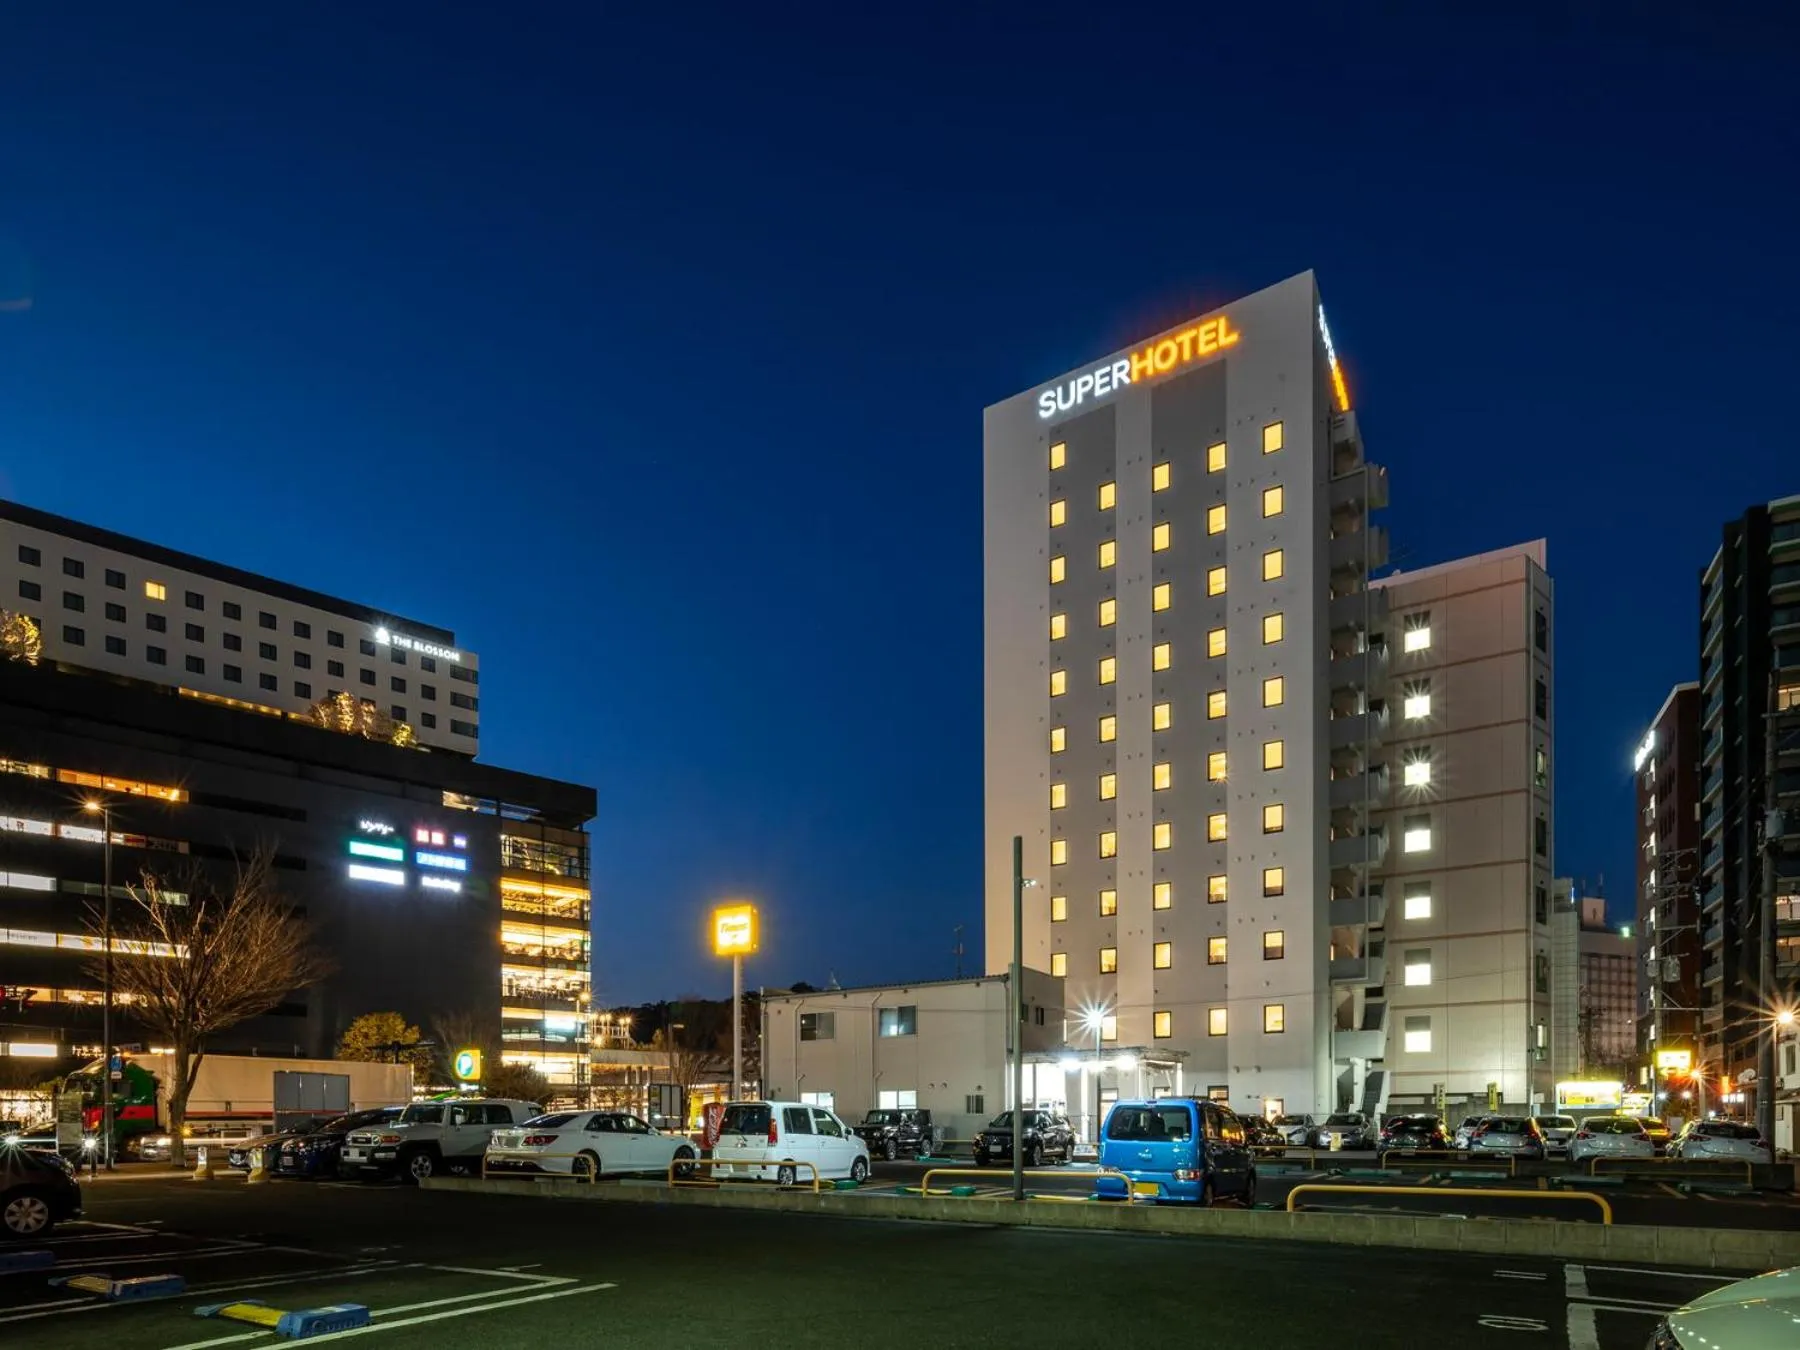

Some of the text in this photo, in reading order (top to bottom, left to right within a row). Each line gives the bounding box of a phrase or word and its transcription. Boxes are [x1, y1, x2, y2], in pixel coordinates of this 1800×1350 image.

[392, 635, 461, 662] THE BLOSSOM
[460, 1055, 473, 1075] P
